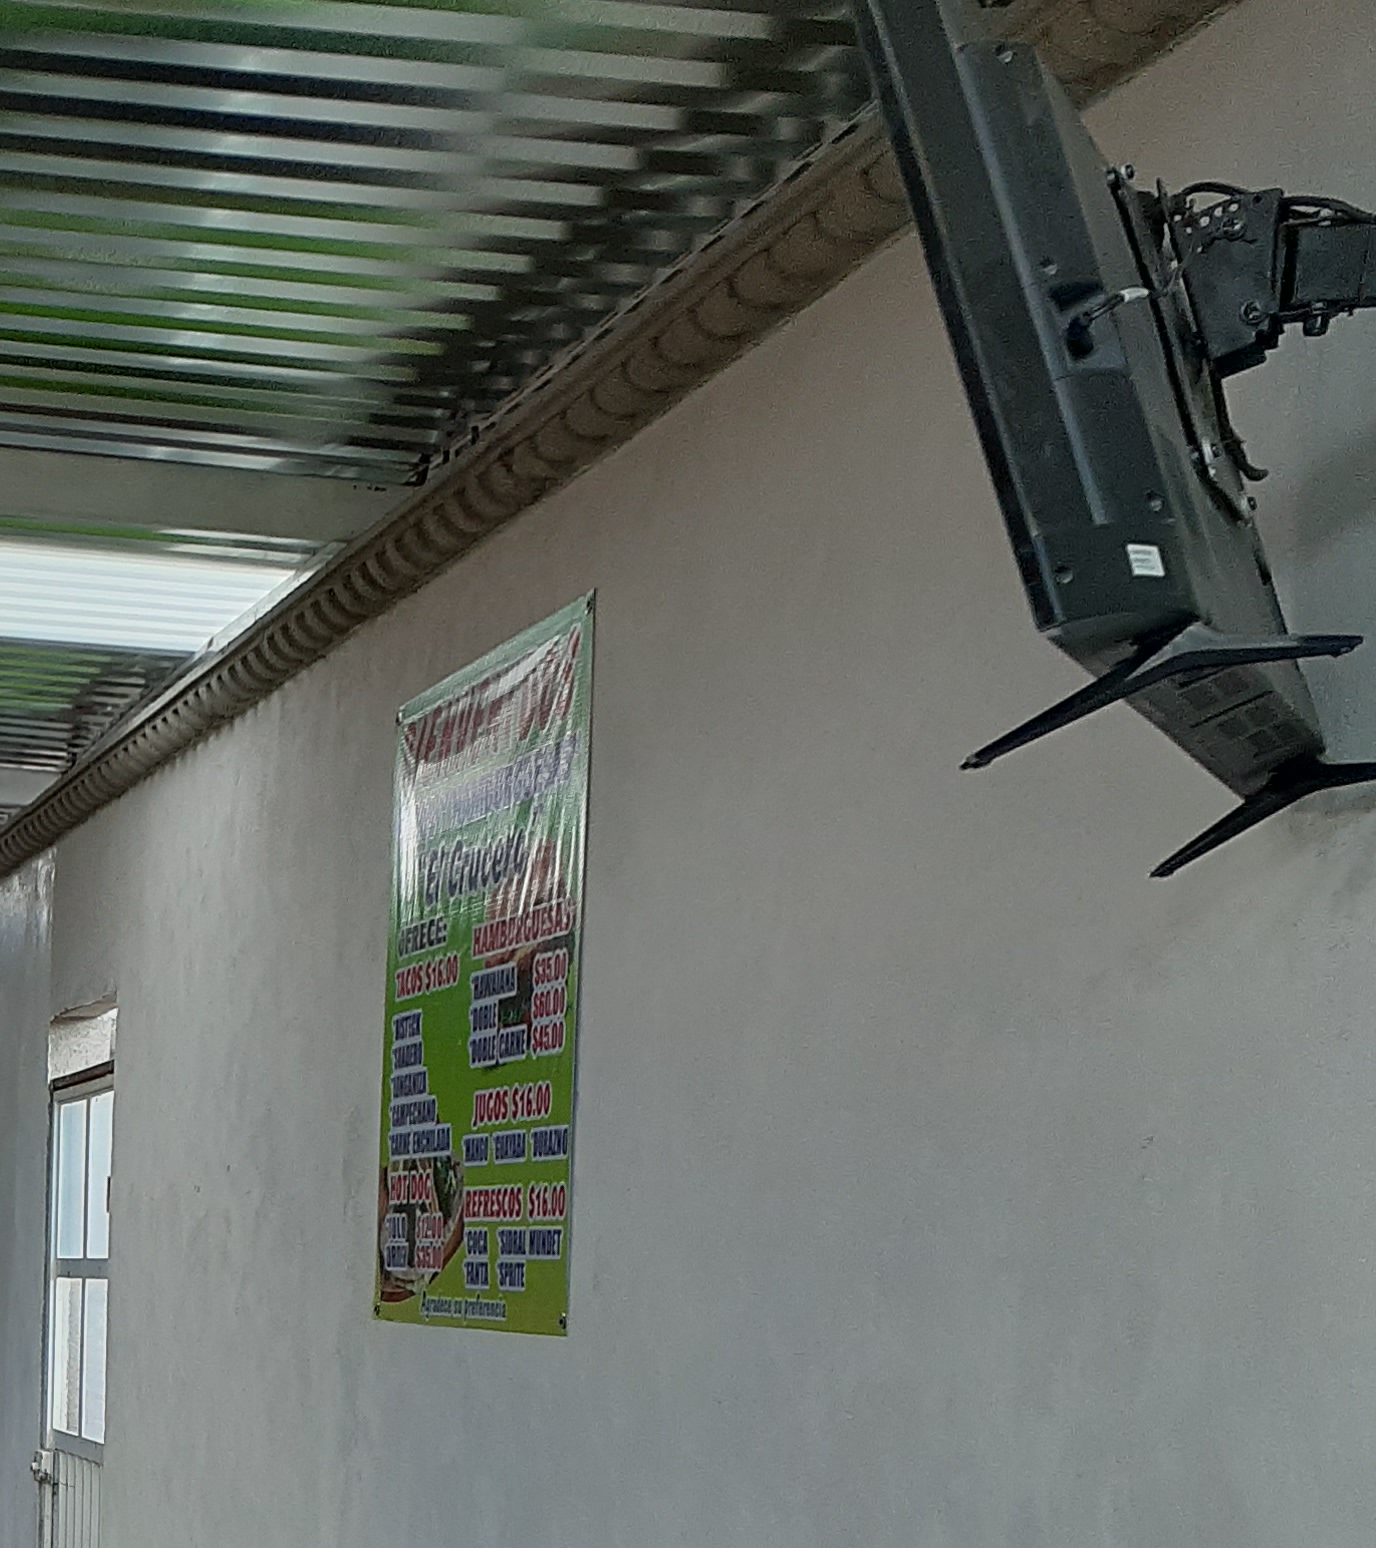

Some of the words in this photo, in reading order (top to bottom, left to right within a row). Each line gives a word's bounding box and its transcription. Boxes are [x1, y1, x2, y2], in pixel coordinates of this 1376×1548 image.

[399, 917, 447, 957] OFRECE:
[473, 903, 572, 957] HAMBURGUESAS
[397, 964, 423, 998] TACOS
[426, 954, 459, 990] $16.00
[534, 951, 567, 985] $35.00
[533, 986, 565, 1019] $60.00
[499, 1029, 526, 1059] CARNE
[533, 1021, 564, 1053] $45.00
[473, 1089, 509, 1127] JUGOS
[512, 1083, 551, 1119] $16.00
[389, 1174, 408, 1201] HOT
[410, 1171, 431, 1200] DOG
[464, 1186, 522, 1220] REFRESCOS
[527, 1182, 566, 1219] $16.00
